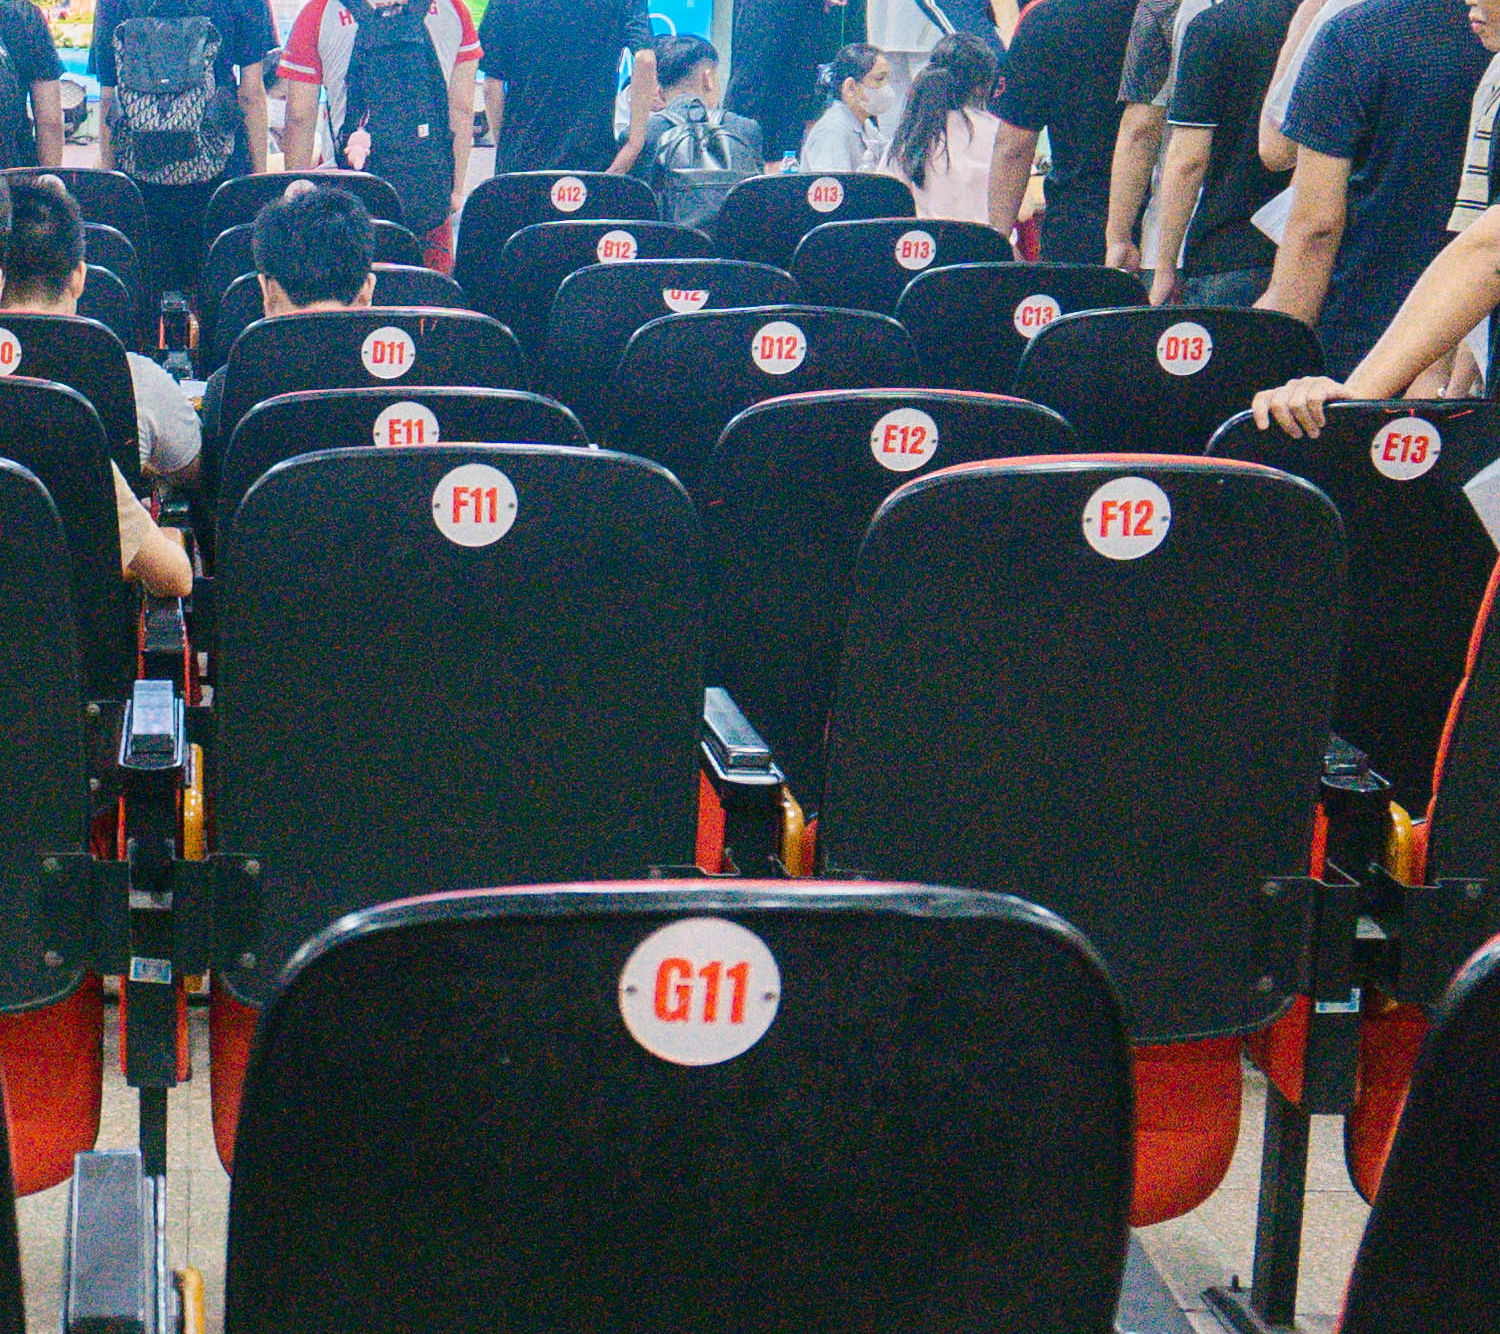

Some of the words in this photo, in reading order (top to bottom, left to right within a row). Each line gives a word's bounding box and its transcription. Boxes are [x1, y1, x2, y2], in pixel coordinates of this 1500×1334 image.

[558, 188, 580, 201] A12
[815, 188, 836, 201] A13
[604, 241, 630, 258] B12
[903, 241, 929, 258] B13
[1022, 307, 1053, 326] C13
[373, 341, 404, 364] D11
[761, 336, 797, 359] D12
[1166, 337, 1203, 360] D13
[389, 419, 424, 446] E11
[883, 425, 926, 454] E12
[1382, 433, 1429, 463] E13
[453, 487, 497, 523] F11
[1100, 500, 1154, 537] F12
[654, 957, 750, 1024] G11
